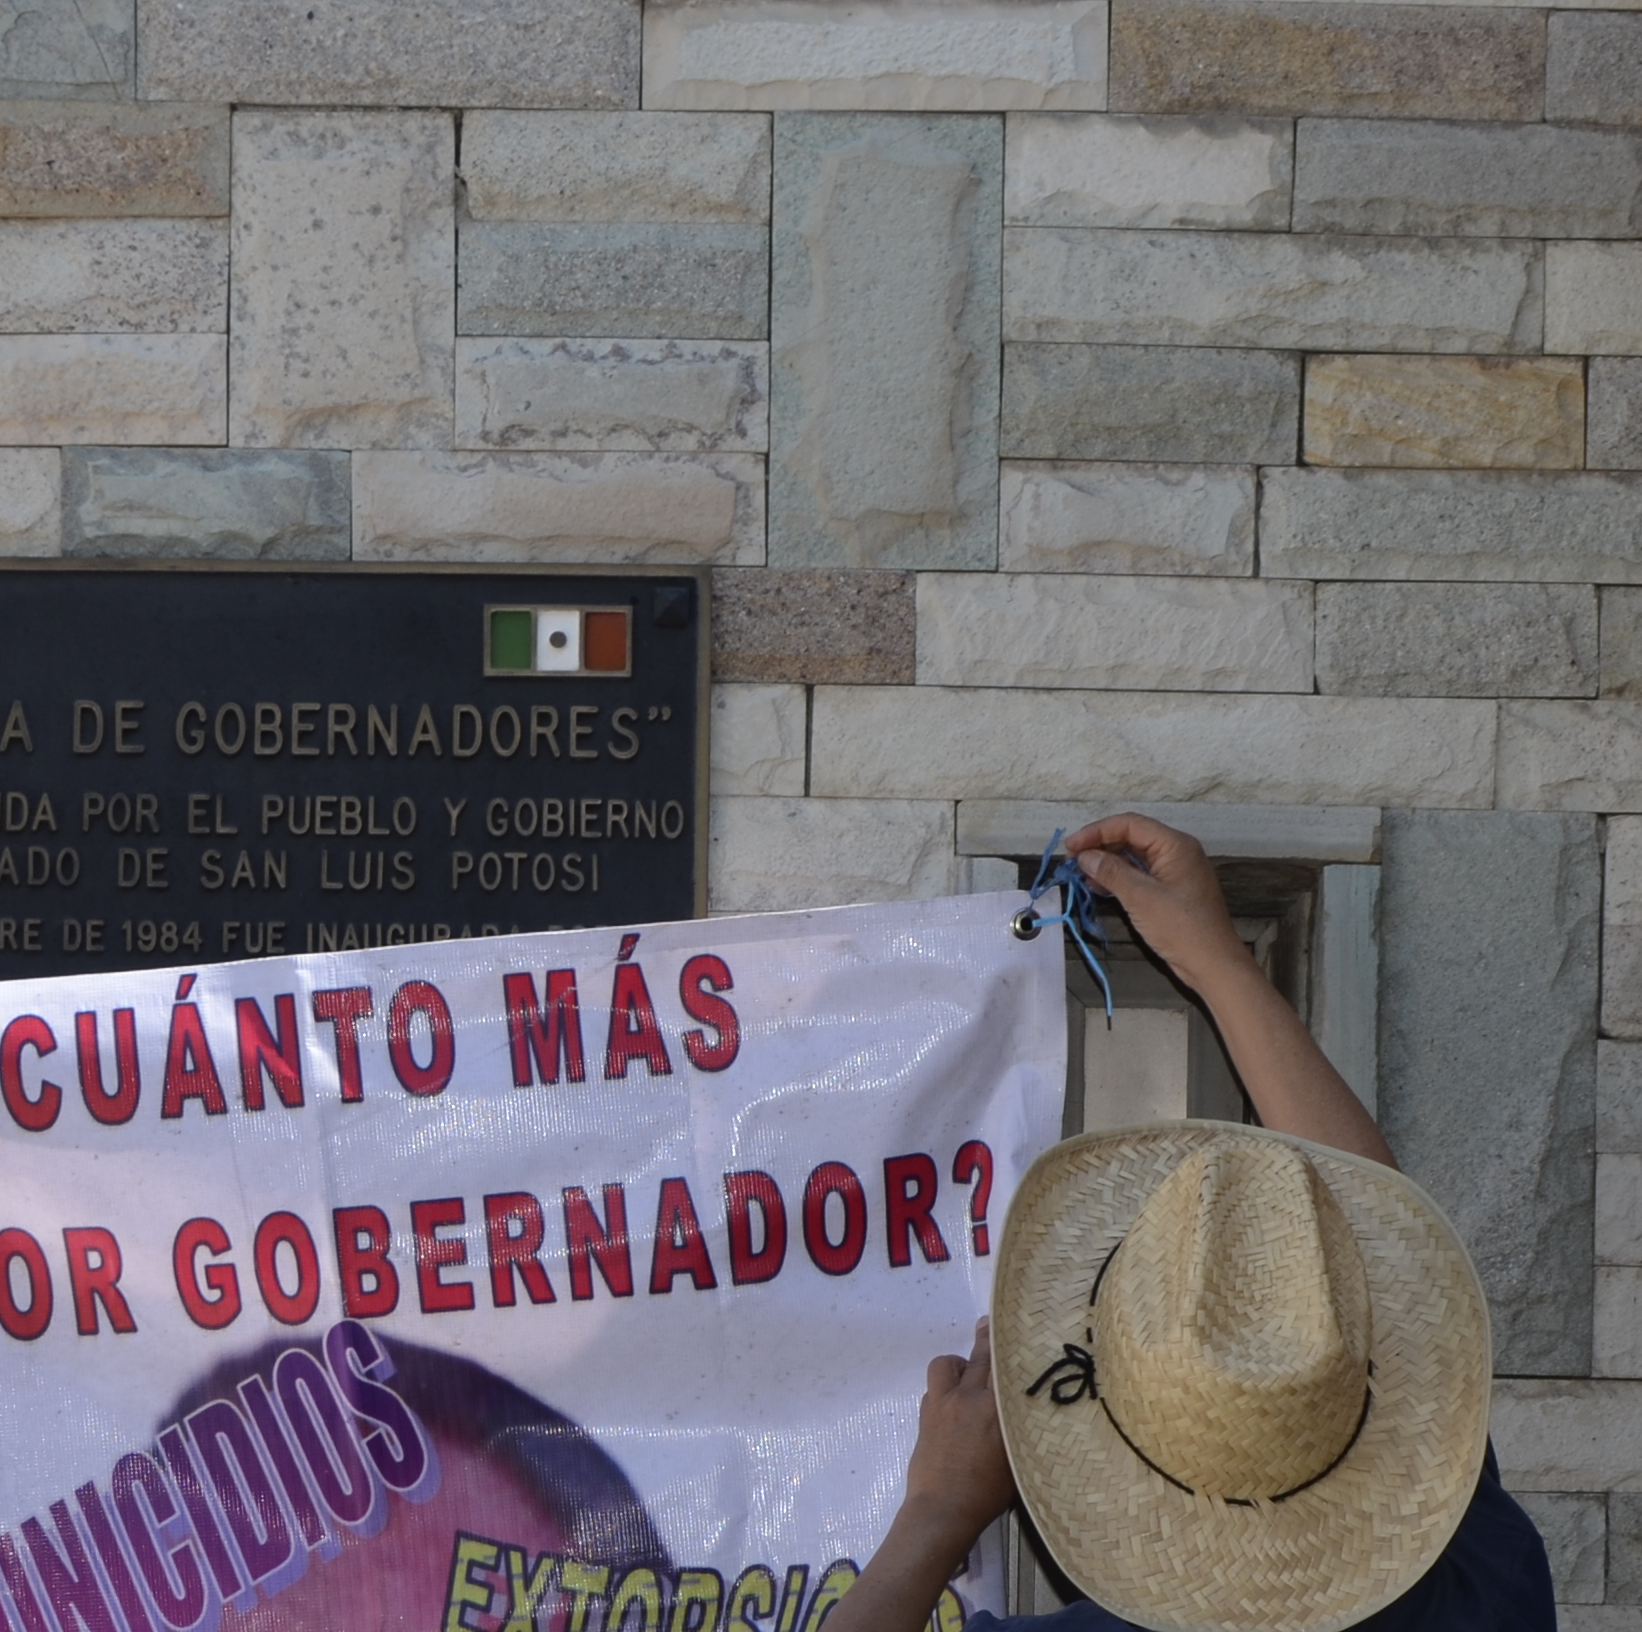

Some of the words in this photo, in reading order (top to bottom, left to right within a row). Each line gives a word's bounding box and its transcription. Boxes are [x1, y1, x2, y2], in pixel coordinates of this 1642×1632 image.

[71, 700, 146, 755] DE
[82, 792, 160, 833] POR
[188, 794, 239, 835] EL
[262, 795, 418, 837] PUEBLO
[443, 797, 469, 837] Y
[485, 798, 685, 840] GOBIERNO
[117, 848, 170, 888] DE
[200, 850, 288, 890] SAN
[320, 850, 416, 891] LUIS
[451, 851, 600, 892] POTOSI
[62, 919, 105, 952] DE
[120, 919, 203, 953] 1984
[221, 921, 286, 954] FUE
[502, 932, 742, 1088] MÁS
[172, 1139, 993, 1331] GOBERNADOR?
